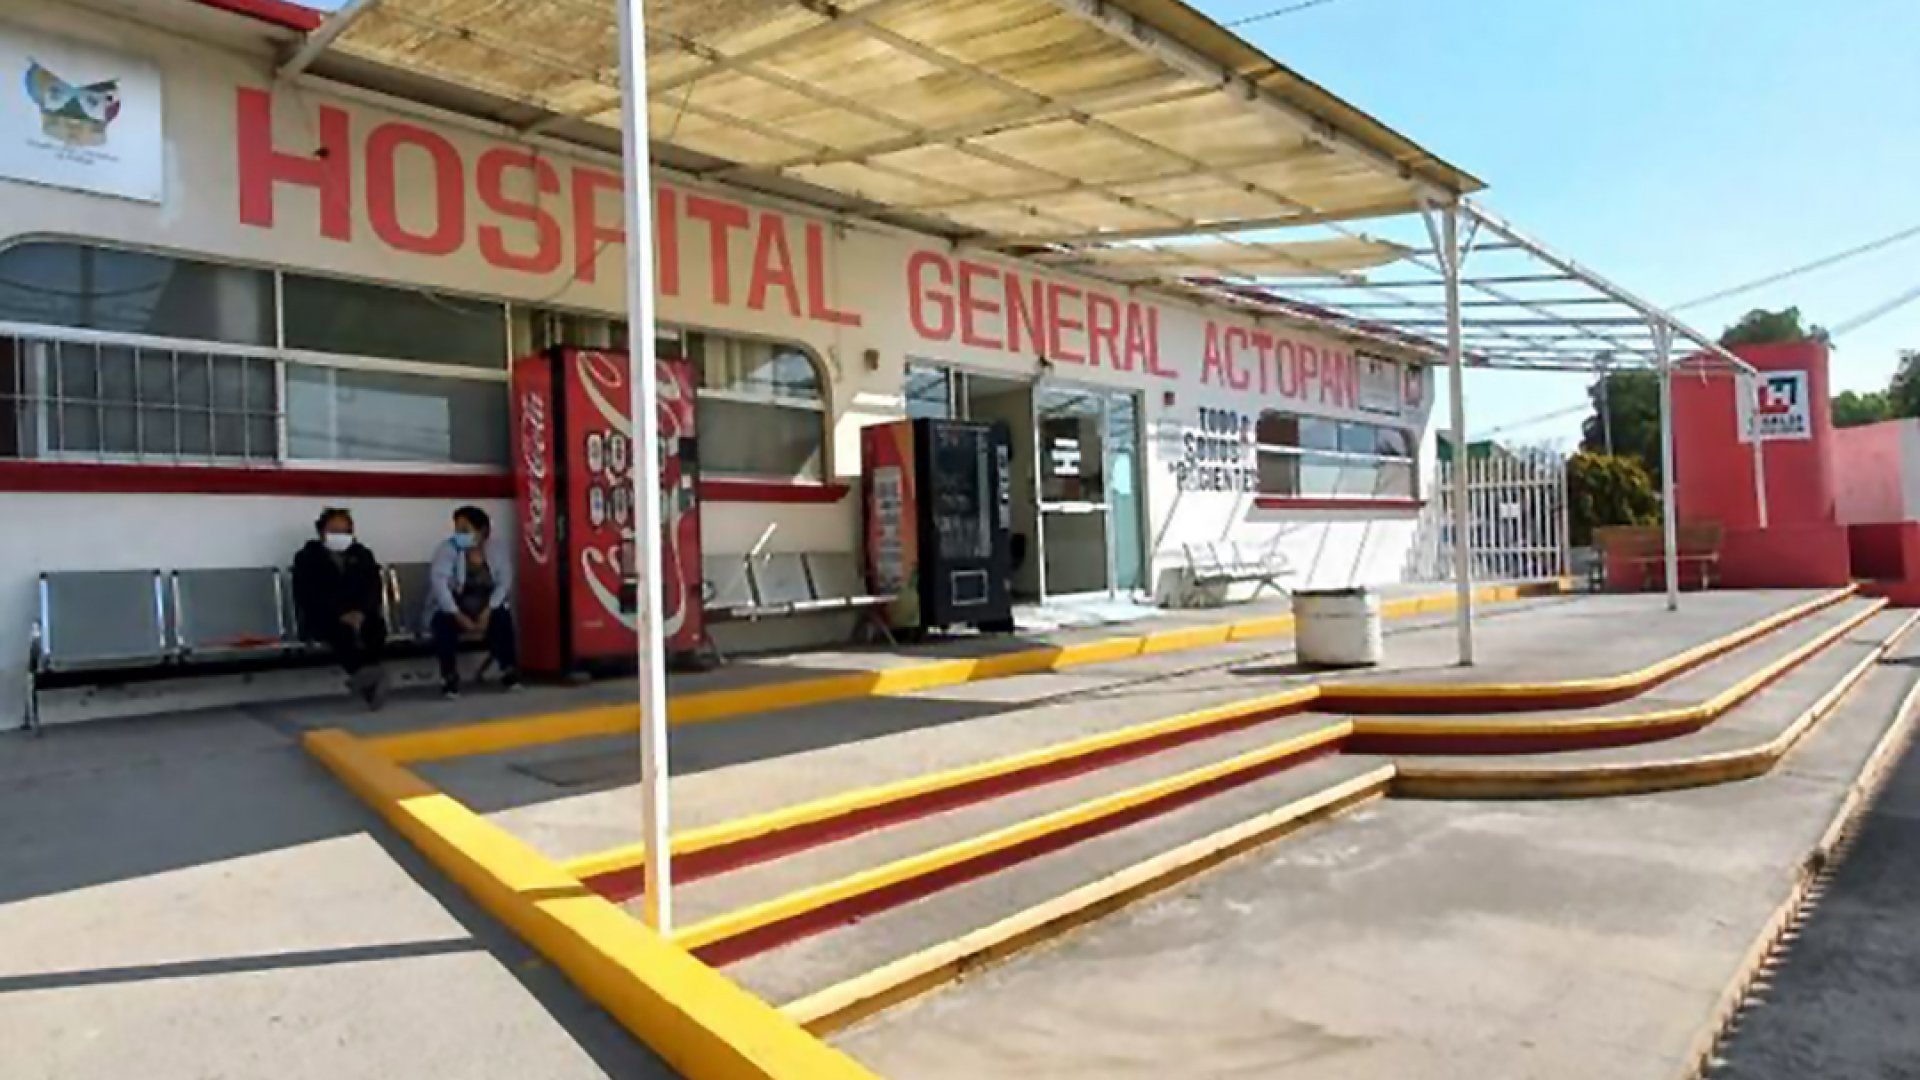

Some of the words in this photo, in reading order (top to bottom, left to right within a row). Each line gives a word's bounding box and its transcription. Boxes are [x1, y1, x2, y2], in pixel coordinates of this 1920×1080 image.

[235, 85, 861, 328] HOSPITAL
[907, 249, 1179, 379] GENERAL
[1200, 321, 1359, 410] ACTOPAN
